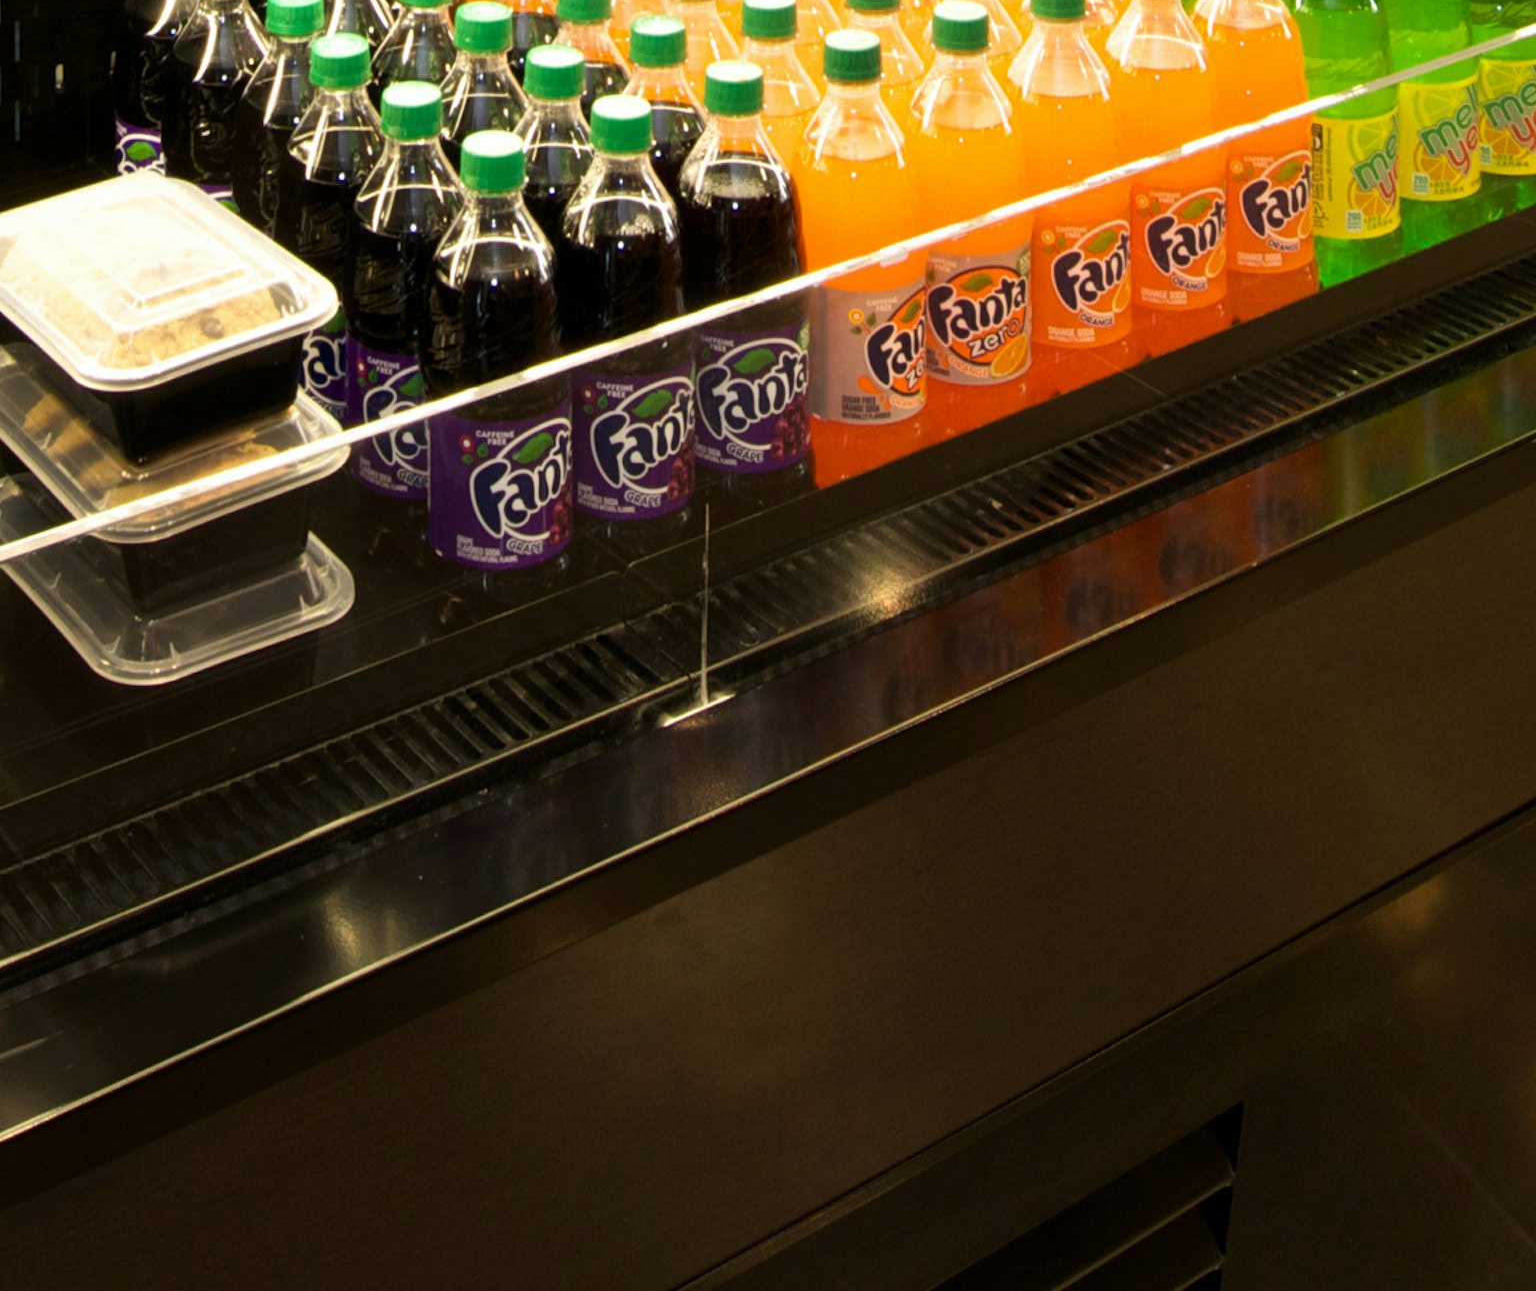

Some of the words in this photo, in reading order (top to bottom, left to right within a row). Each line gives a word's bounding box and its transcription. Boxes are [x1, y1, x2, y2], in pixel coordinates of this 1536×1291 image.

[1240, 160, 1312, 238] Fant
[1056, 226, 1088, 235] CAFFEINE
[1145, 198, 1227, 274] Fant
[1266, 238, 1300, 252] ORANGE
[1051, 232, 1131, 313] Fant
[1172, 275, 1208, 291] ORANGE
[866, 296, 899, 307] CAFFEINE
[876, 304, 893, 313] FREE
[926, 276, 1027, 347] Fanta
[1079, 312, 1115, 328] ORANGE
[967, 316, 1021, 359] zero
[709, 343, 727, 353] FREE
[866, 316, 926, 390] Fan
[366, 355, 401, 370] CAFFEINE
[376, 364, 394, 376] FREE
[948, 357, 989, 378] ORANGE
[595, 381, 634, 393] CAFFEINE
[607, 390, 627, 399] FREE
[696, 349, 809, 440] Fanta
[475, 429, 515, 439] CAFFEINE
[487, 437, 507, 447] FREE
[590, 388, 695, 489] Fant
[727, 442, 764, 463] GRAPE
[470, 429, 572, 539] Fant
[624, 489, 662, 507] GRAPE
[507, 538, 544, 555] GRAPE
